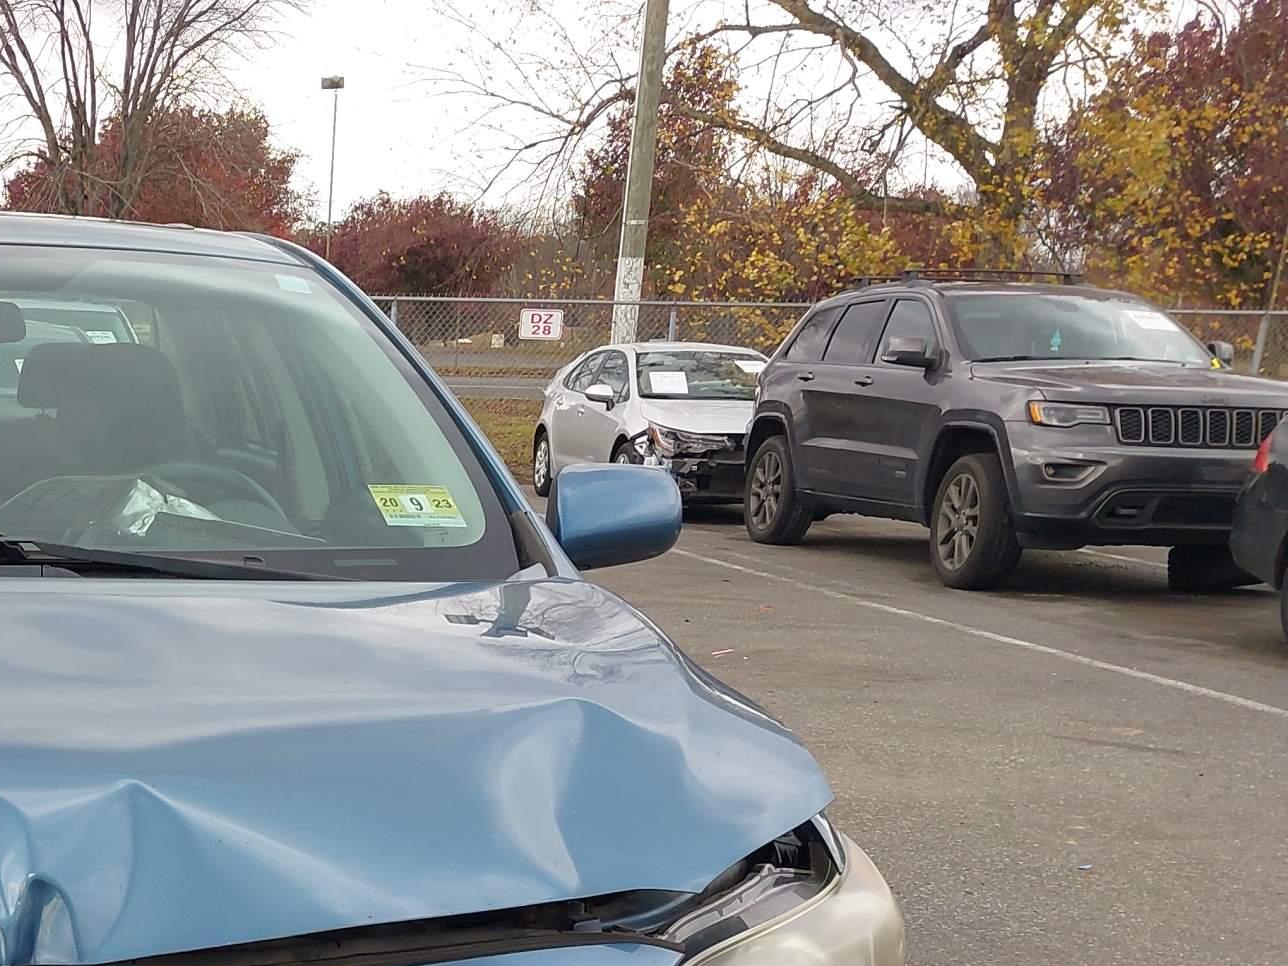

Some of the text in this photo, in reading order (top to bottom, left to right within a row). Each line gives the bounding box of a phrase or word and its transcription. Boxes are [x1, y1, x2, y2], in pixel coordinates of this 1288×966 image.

[530, 313, 554, 324] DZ
[531, 325, 552, 335] 28
[379, 496, 452, 512] 20 9 23
